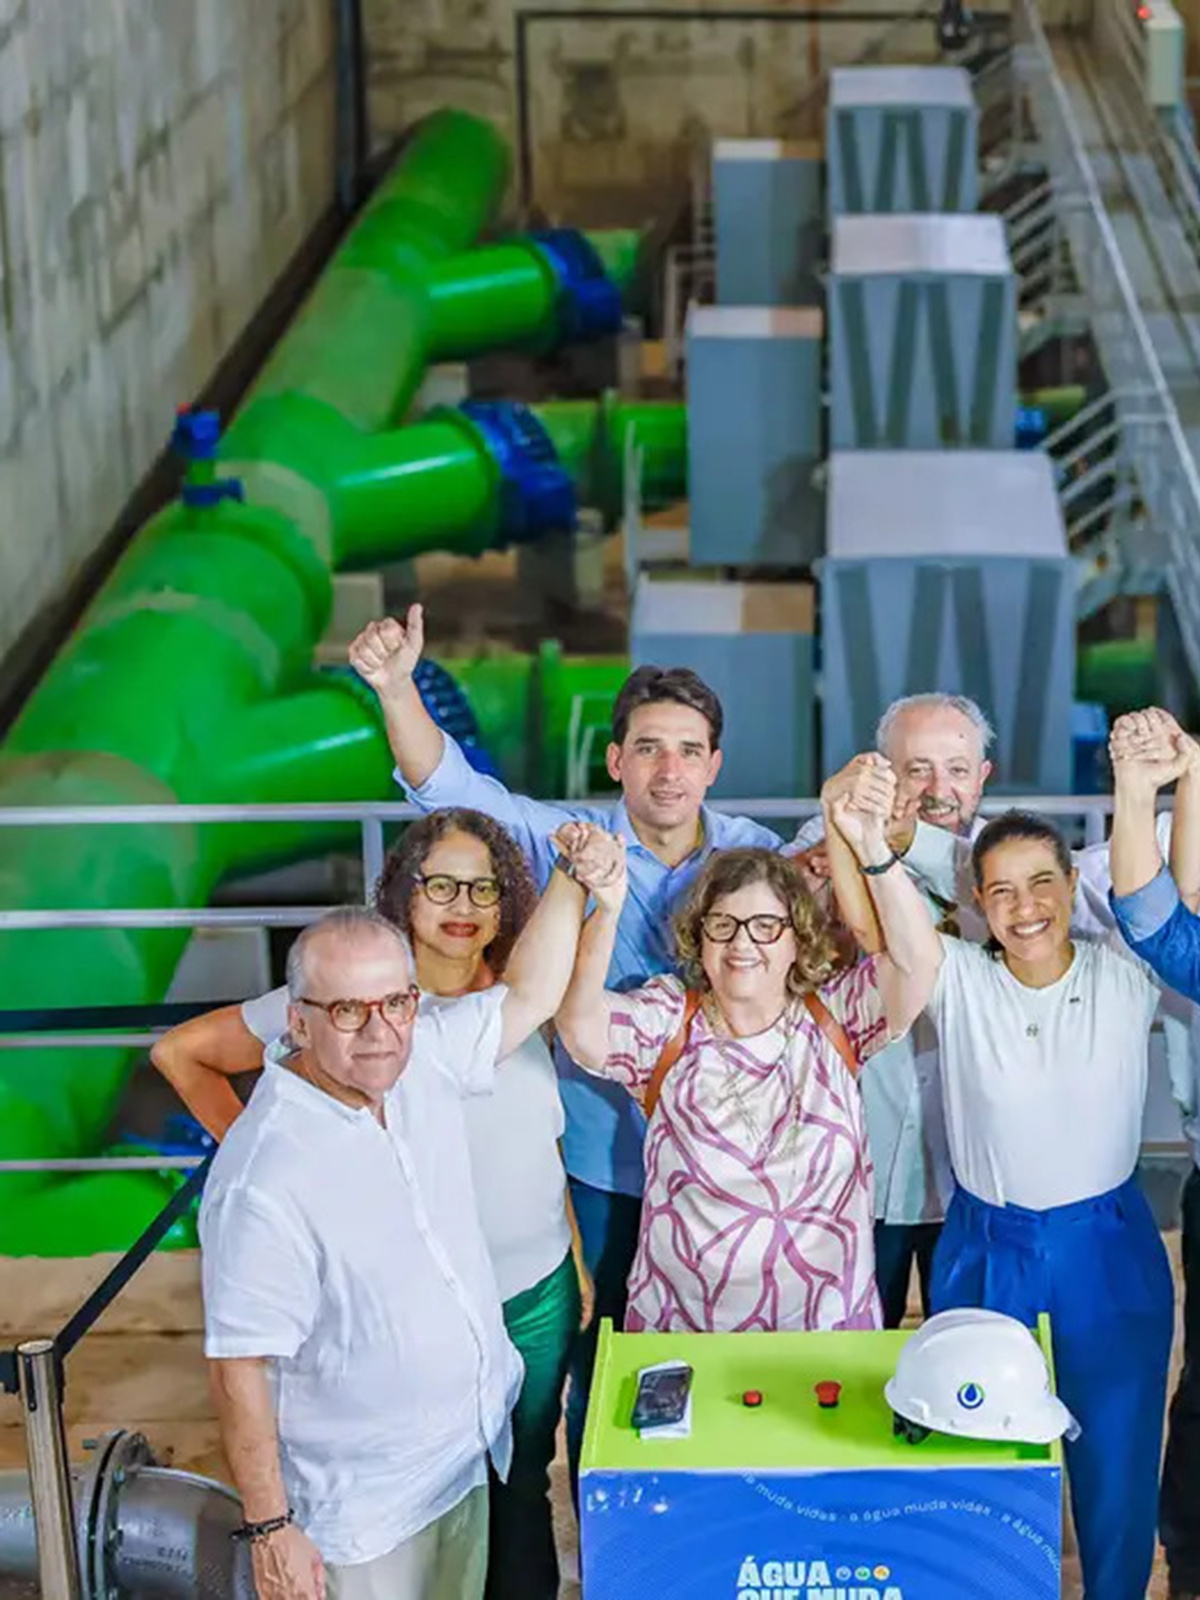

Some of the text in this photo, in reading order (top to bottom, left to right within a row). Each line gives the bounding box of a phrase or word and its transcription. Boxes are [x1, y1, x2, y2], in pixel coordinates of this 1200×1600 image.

[755, 1484, 793, 1510] muda
[796, 1504, 838, 1523] vidas
[903, 1498, 947, 1515] muda
[951, 1498, 992, 1517] vidas
[736, 1554, 832, 1588] ÁGUA
